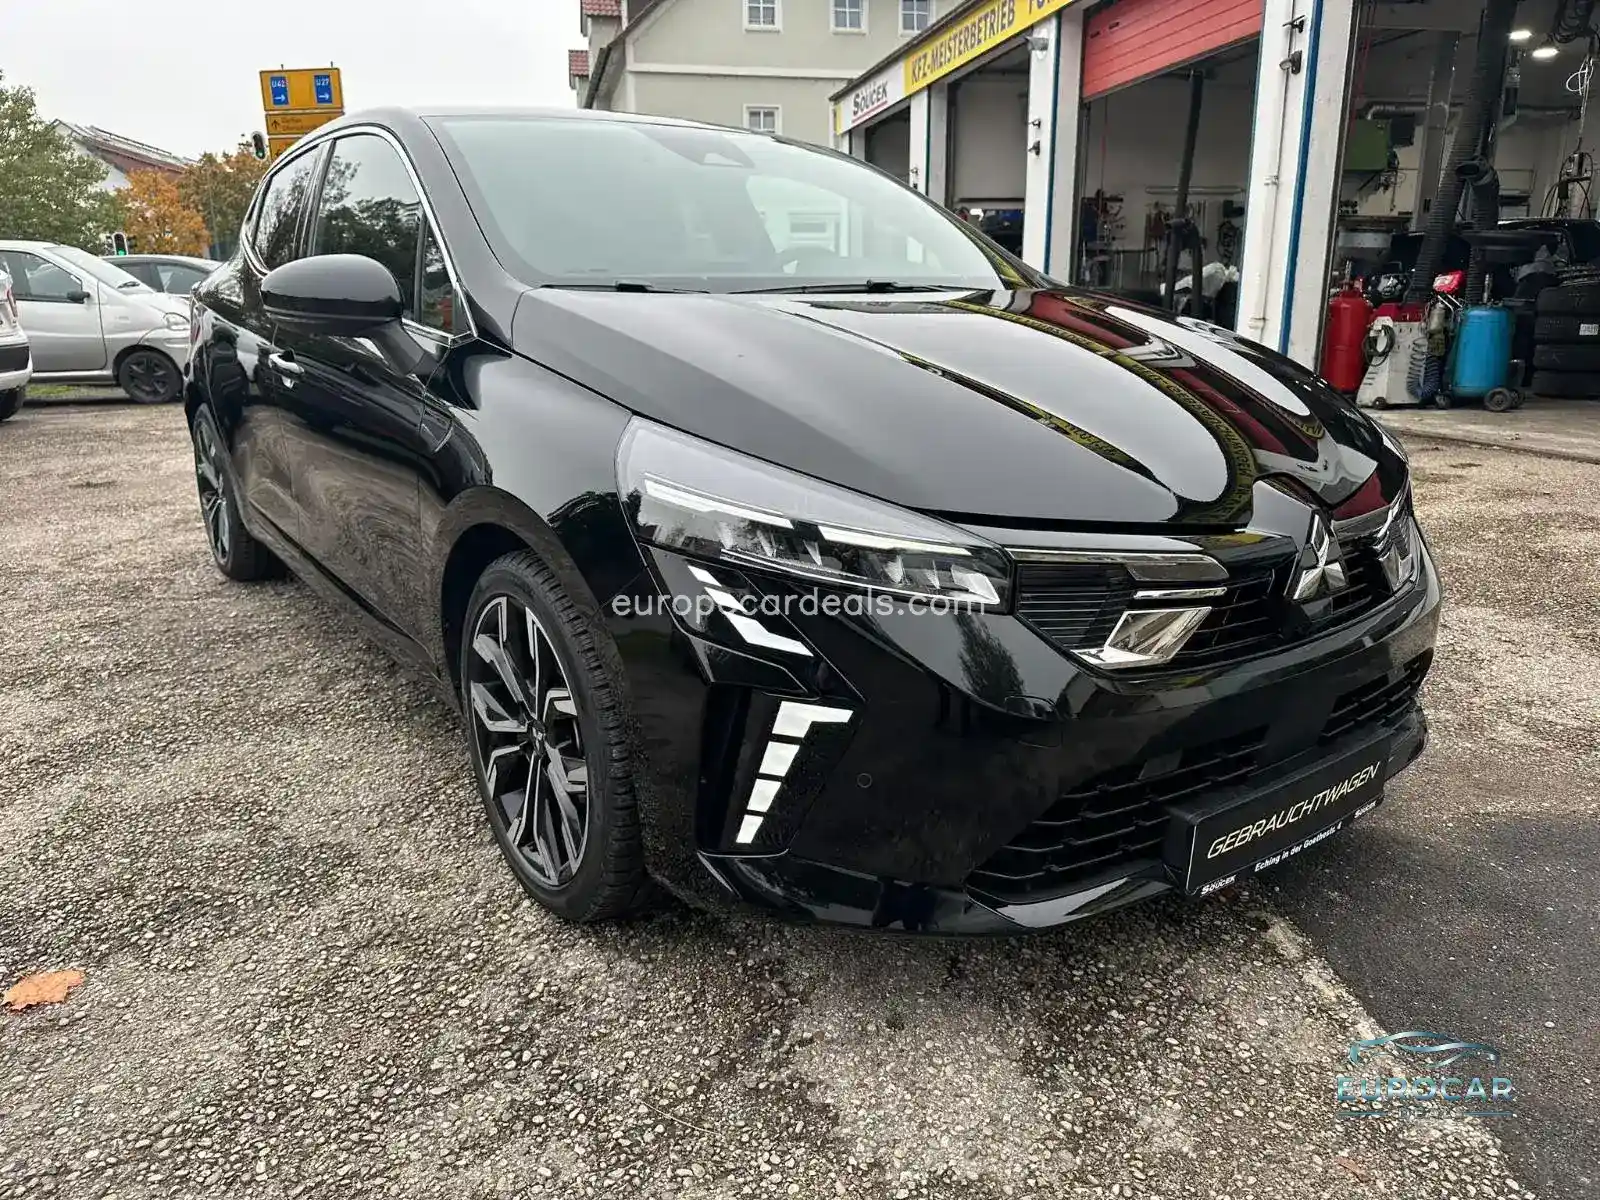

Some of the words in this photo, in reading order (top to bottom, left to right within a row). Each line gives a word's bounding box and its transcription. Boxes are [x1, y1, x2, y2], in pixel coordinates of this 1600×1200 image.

[911, 0, 1015, 84] KFZ-MEISTERBETRIEB
[1207, 761, 1381, 859] GEBRAUCHTWAGEN
[1254, 855, 1281, 872] Eching
[1281, 850, 1289, 860] in
[1290, 844, 1303, 856] der
